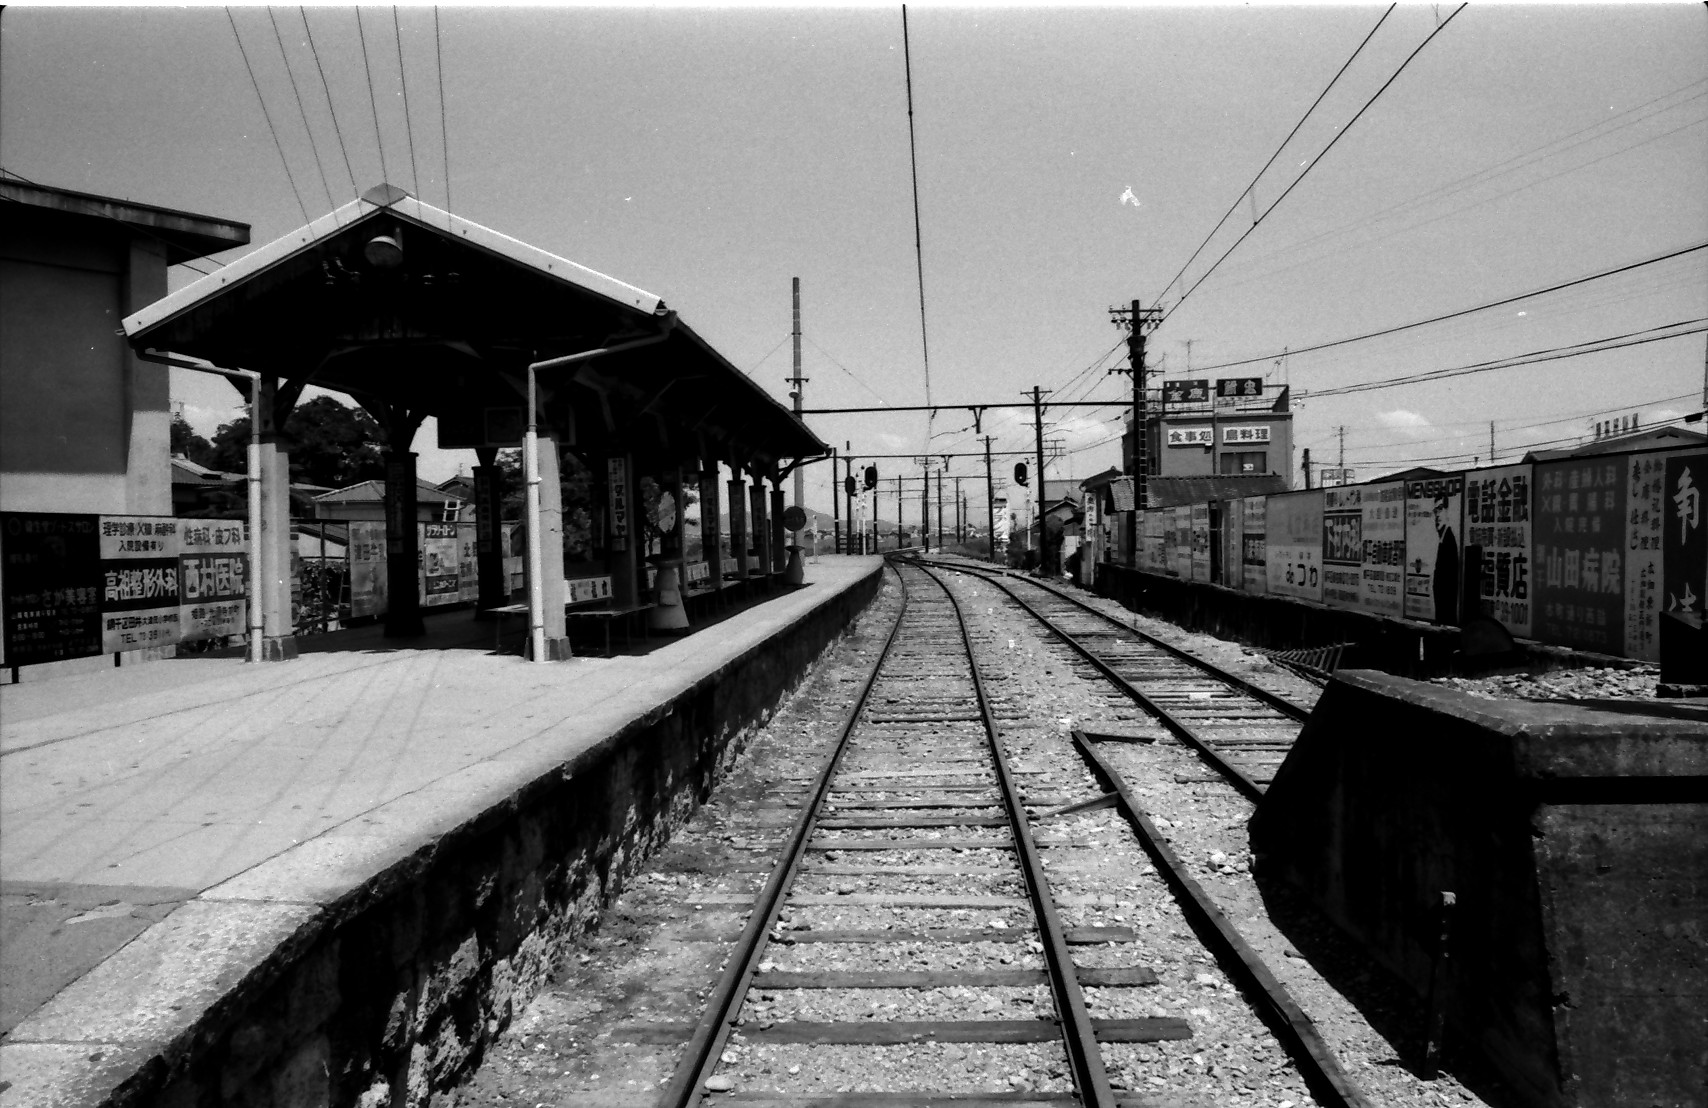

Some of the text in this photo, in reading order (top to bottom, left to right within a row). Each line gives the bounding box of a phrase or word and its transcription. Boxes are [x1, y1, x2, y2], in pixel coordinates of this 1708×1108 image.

[1170, 430, 1212, 443] 食事処
[1467, 475, 1529, 524] 電話金融
[118, 539, 165, 552] 入院設備有り
[183, 557, 244, 599] 西村医院
[1546, 546, 1622, 595] 山田病院
[120, 633, 138, 644] TEL
